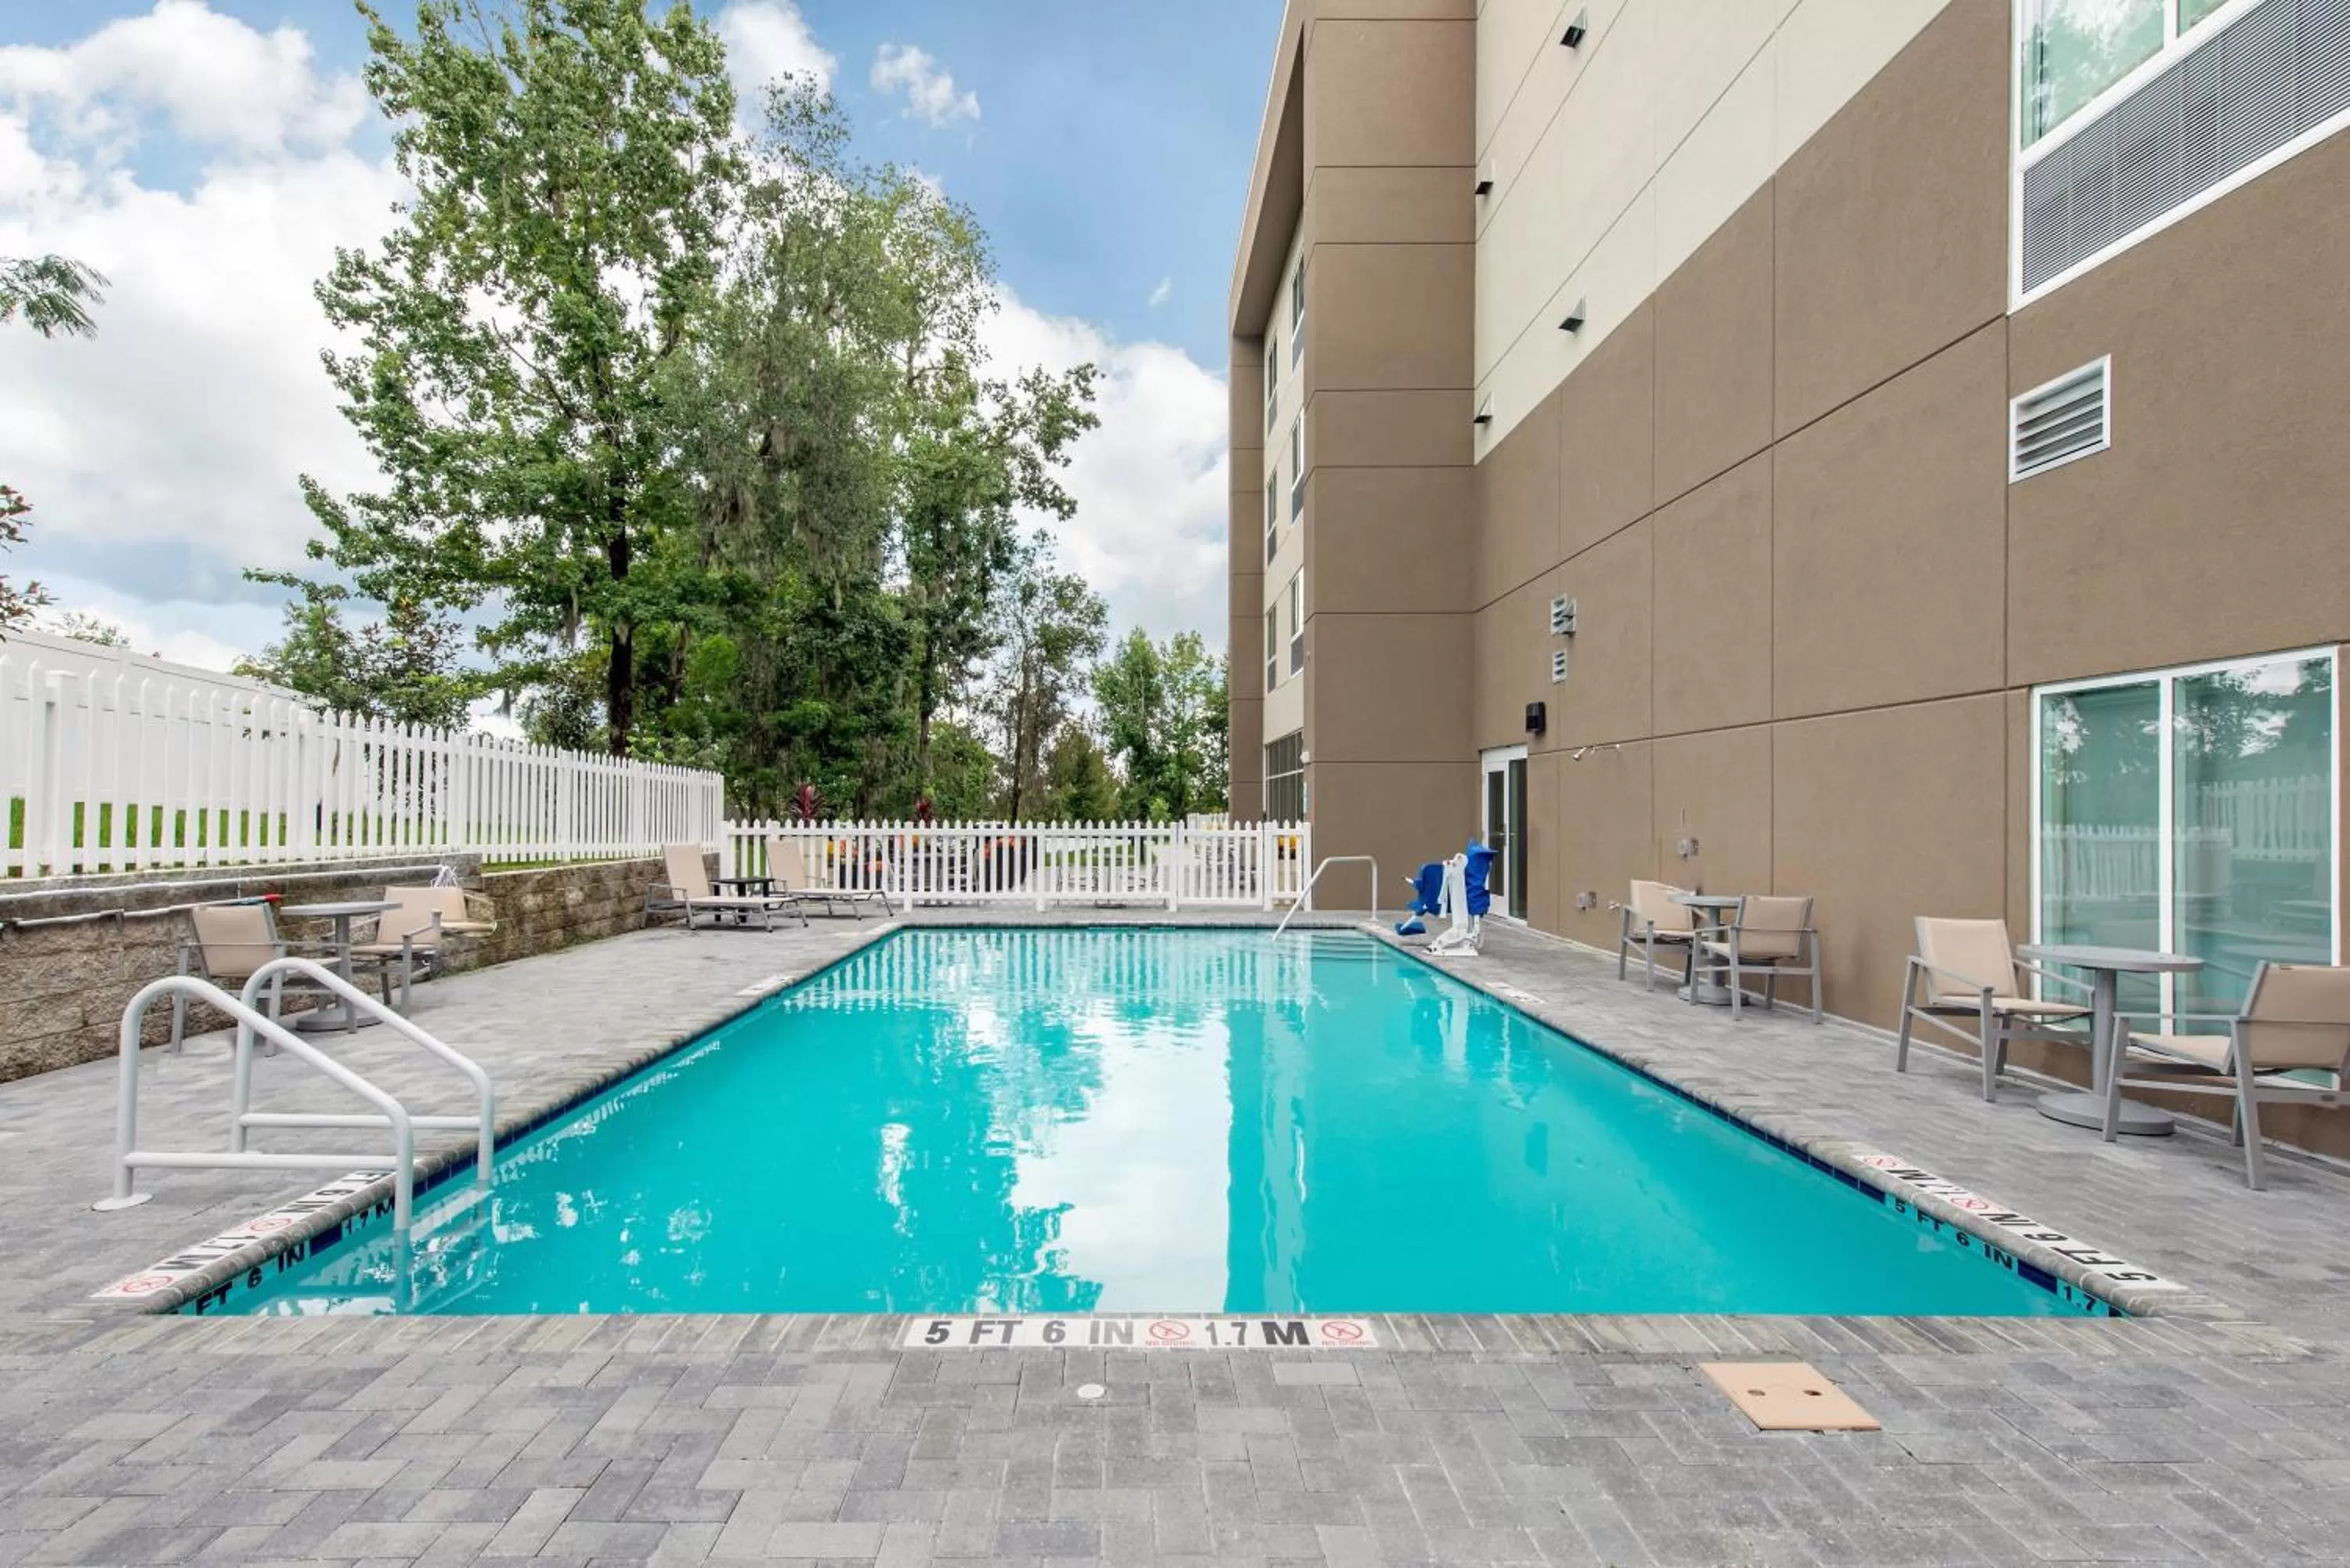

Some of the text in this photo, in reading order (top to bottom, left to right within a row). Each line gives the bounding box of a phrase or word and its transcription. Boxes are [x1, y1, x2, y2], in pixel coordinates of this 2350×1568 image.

[1885, 1169, 1938, 1180] M
[1978, 1213, 2041, 1227] IN
[1896, 1196, 1906, 1214] 5
[1917, 1209, 1944, 1232] FT
[1956, 1232, 1970, 1247] 6
[1983, 1243, 2013, 1270] IN
[2023, 1233, 2069, 1242] 6
[2050, 1246, 2125, 1265] FT
[247, 1266, 263, 1289] 6
[2105, 1272, 2158, 1281] 5
[924, 1320, 1311, 1346] 5 FT 6 IN 1.7 M
